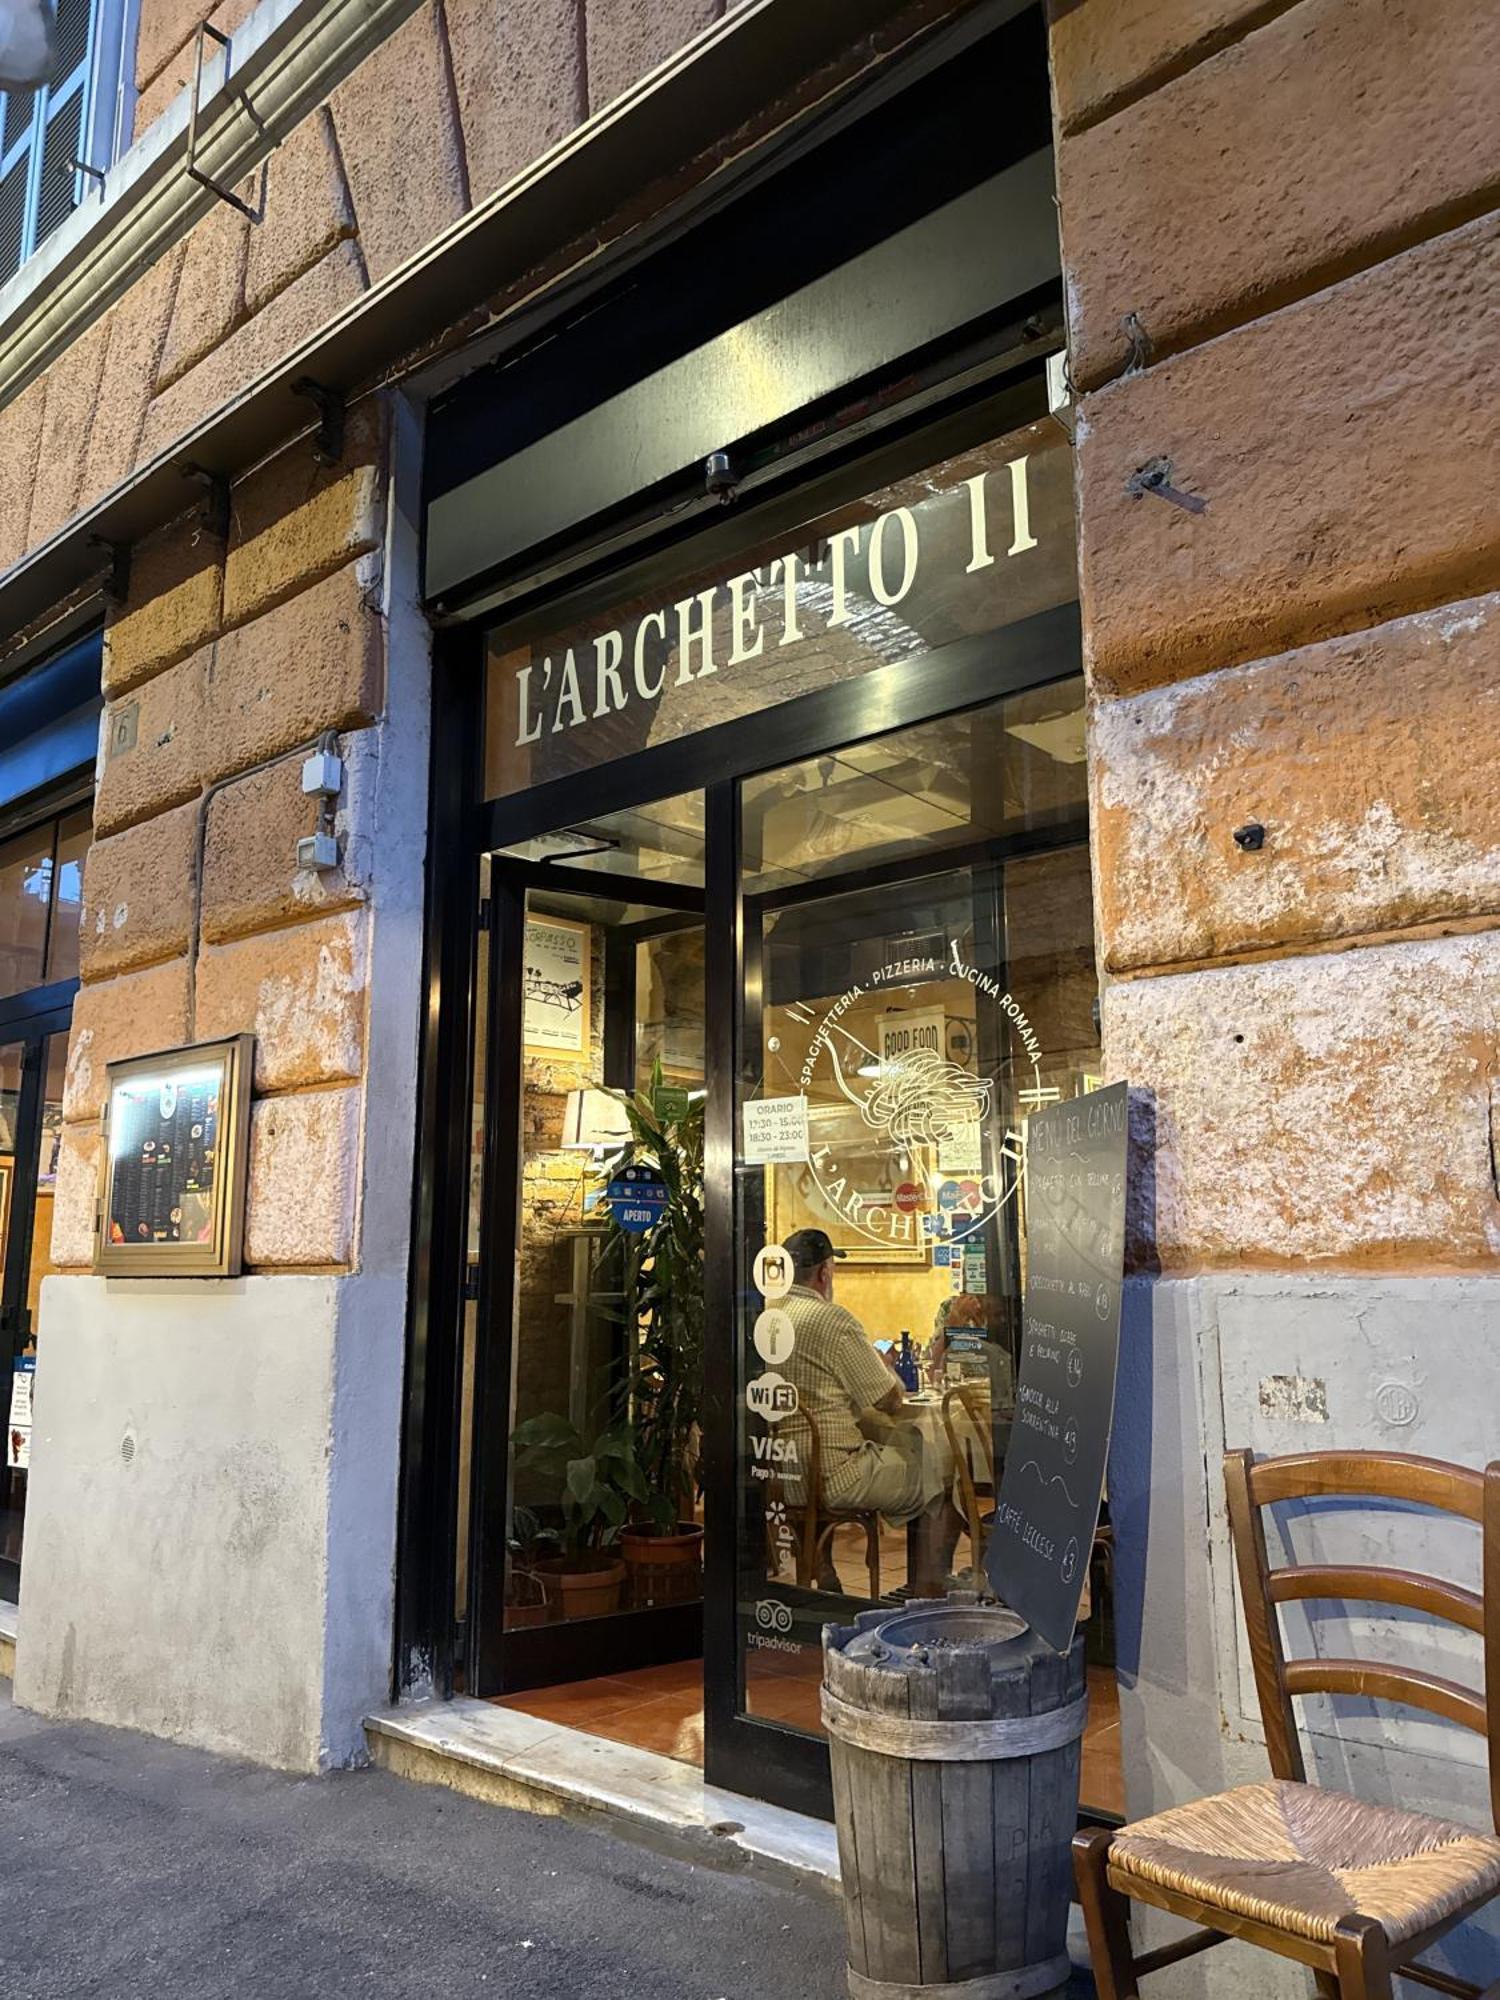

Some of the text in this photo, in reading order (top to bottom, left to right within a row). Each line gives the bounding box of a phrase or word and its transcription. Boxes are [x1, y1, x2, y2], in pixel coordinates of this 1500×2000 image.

[515, 455, 1038, 748] L'ARCHETTO II
[801, 958, 1043, 1085] SPAGHETTERIA PIZZERIA CUCINA ROMANA
[885, 1025, 938, 1060] GOOD FOOD
[757, 1103, 794, 1115] ORARIO
[811, 1144, 1002, 1240] L'ARCHETTO
[623, 1209, 652, 1222] APERTO
[749, 1435, 798, 1463] VISA
[747, 1631, 802, 1655] tripadvisor
